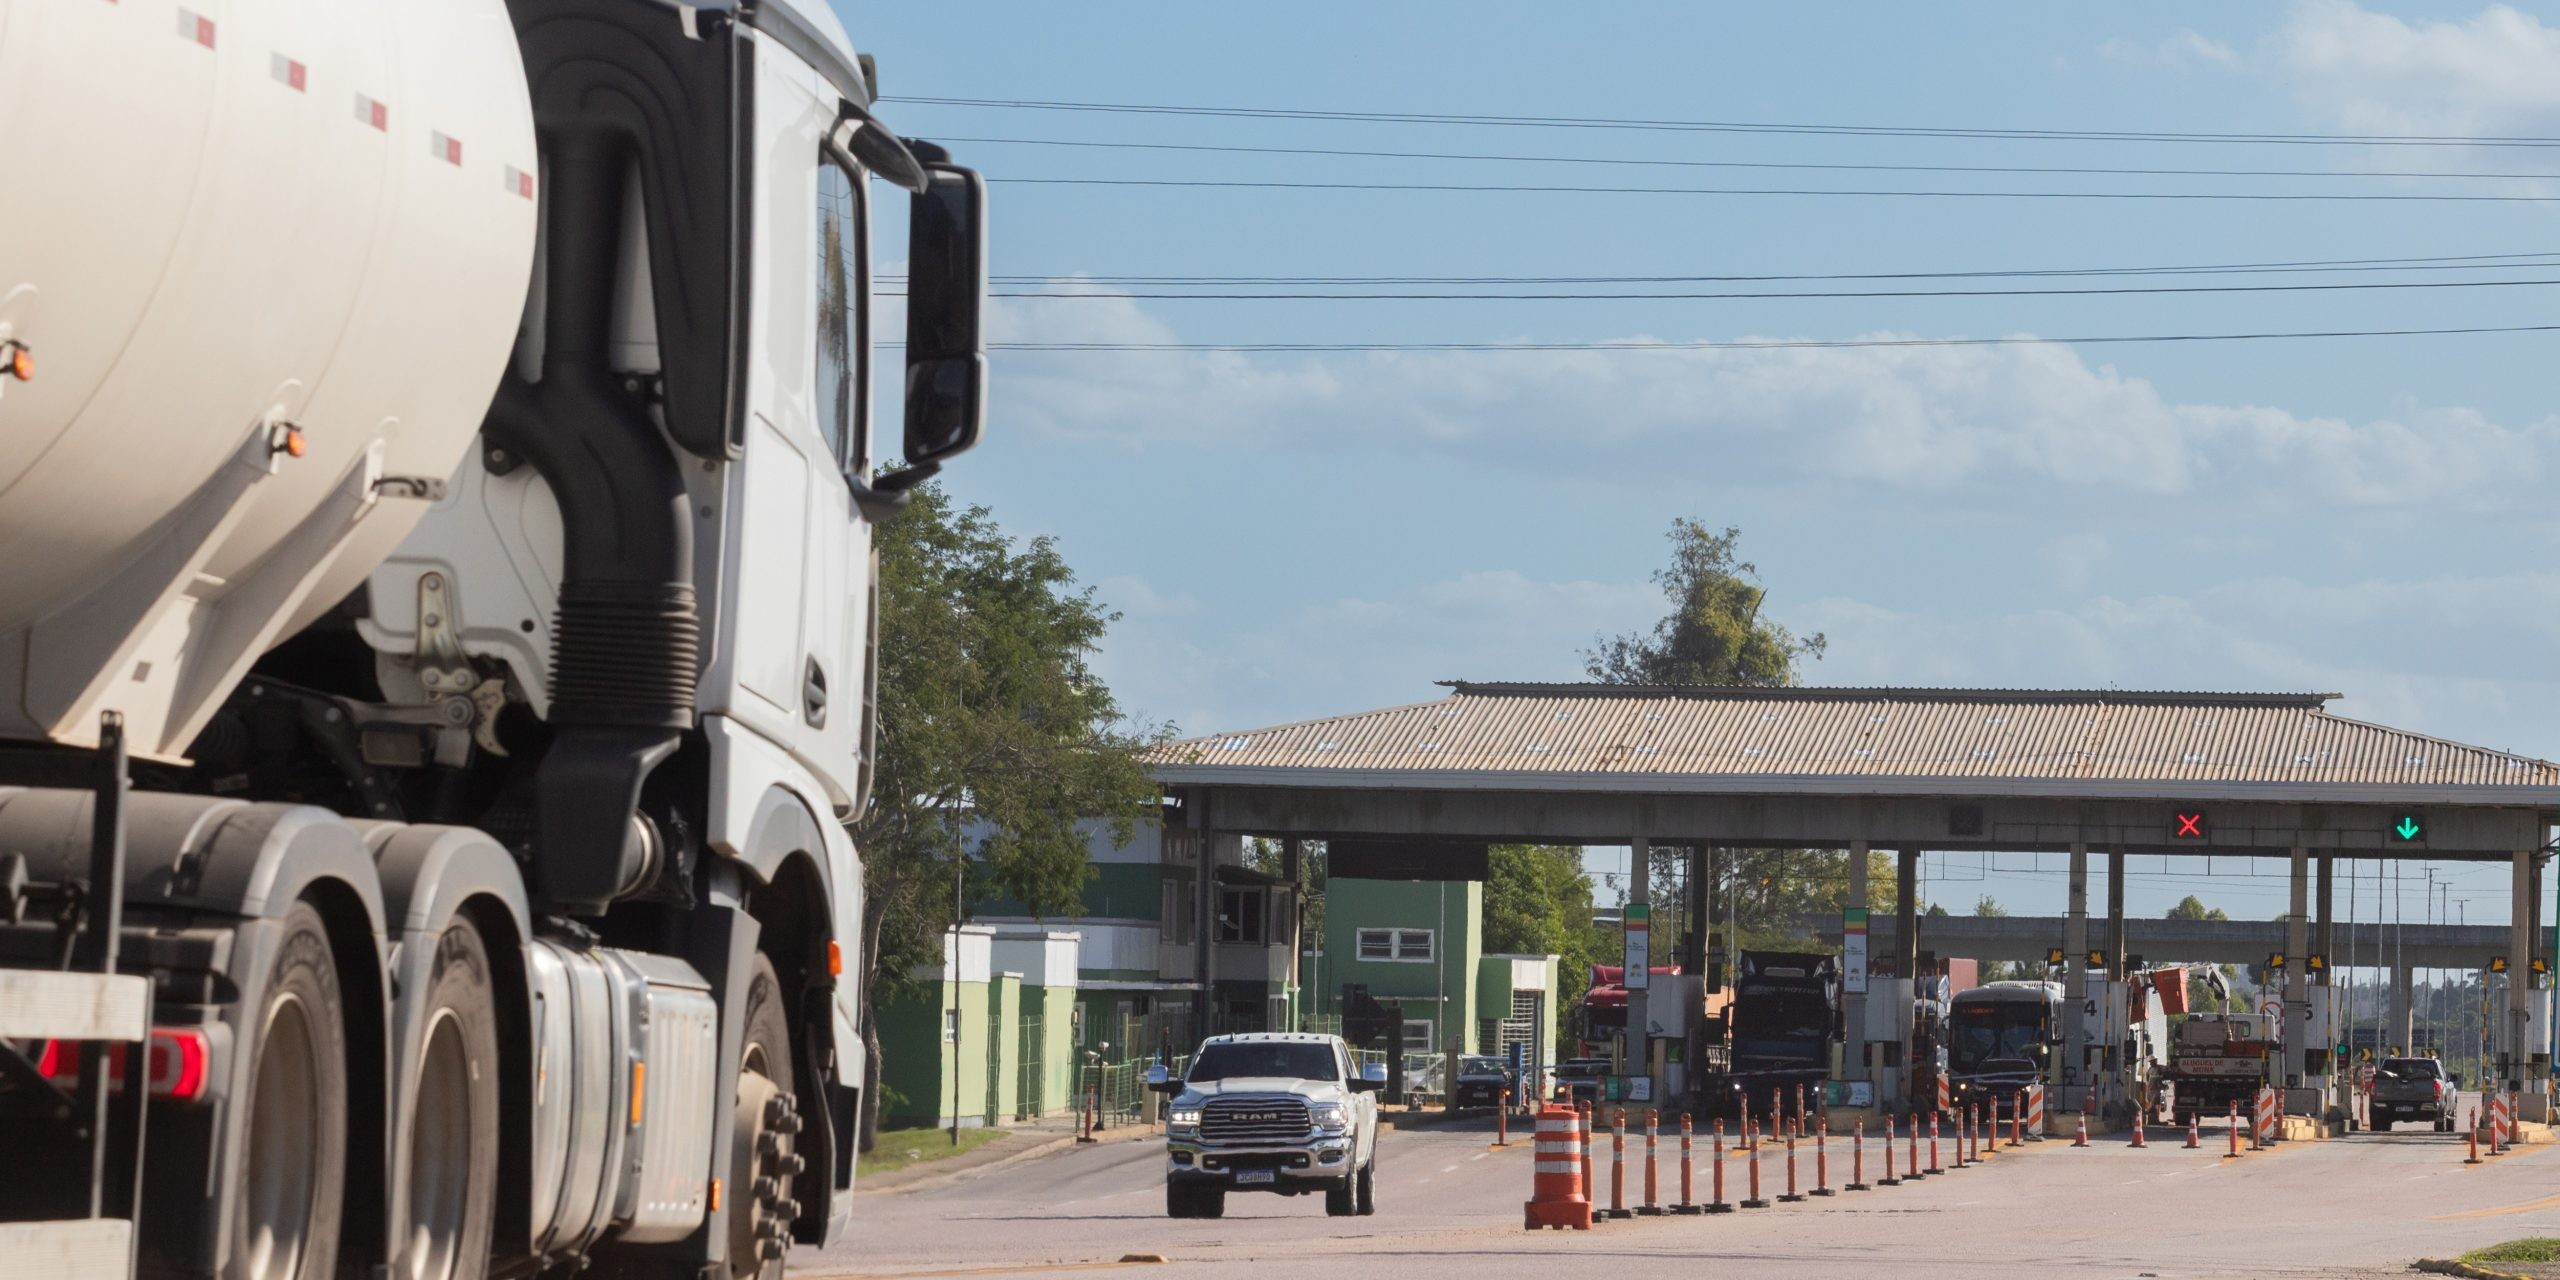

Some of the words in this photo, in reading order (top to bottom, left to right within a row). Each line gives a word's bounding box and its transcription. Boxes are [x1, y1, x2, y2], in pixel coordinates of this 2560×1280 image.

[2083, 999, 2097, 1016] 4
[2304, 1003, 2314, 1021] 5
[1232, 1112, 1278, 1120] RAM
